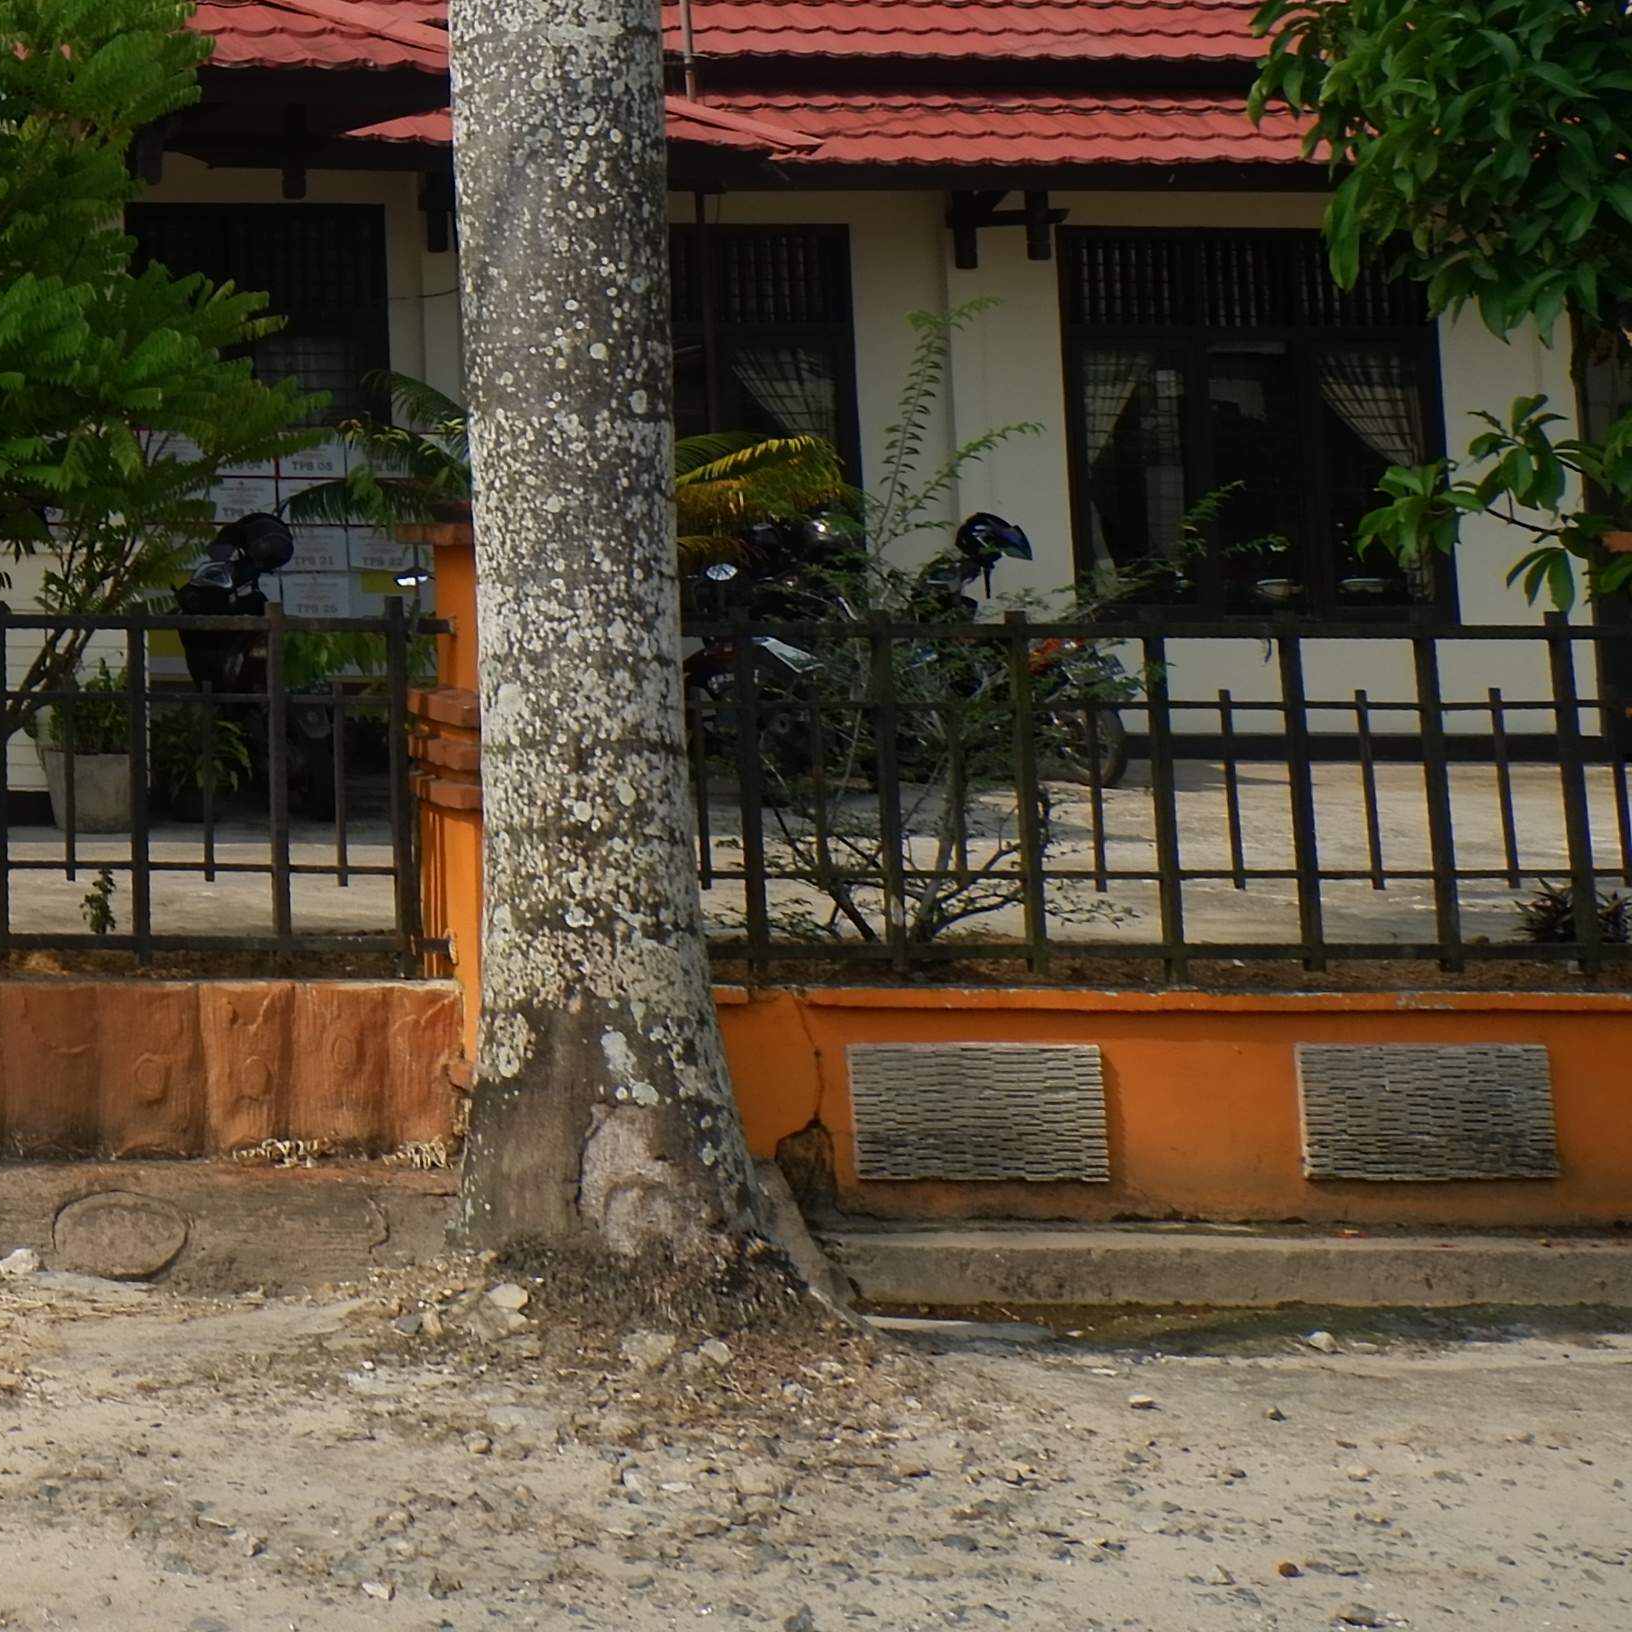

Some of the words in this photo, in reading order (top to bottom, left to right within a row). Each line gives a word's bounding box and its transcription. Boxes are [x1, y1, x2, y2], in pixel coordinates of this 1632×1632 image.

[291, 460, 315, 471] TPS
[293, 555, 316, 566] TPS
[361, 556, 385, 566] TPS
[296, 603, 319, 614] TPS
